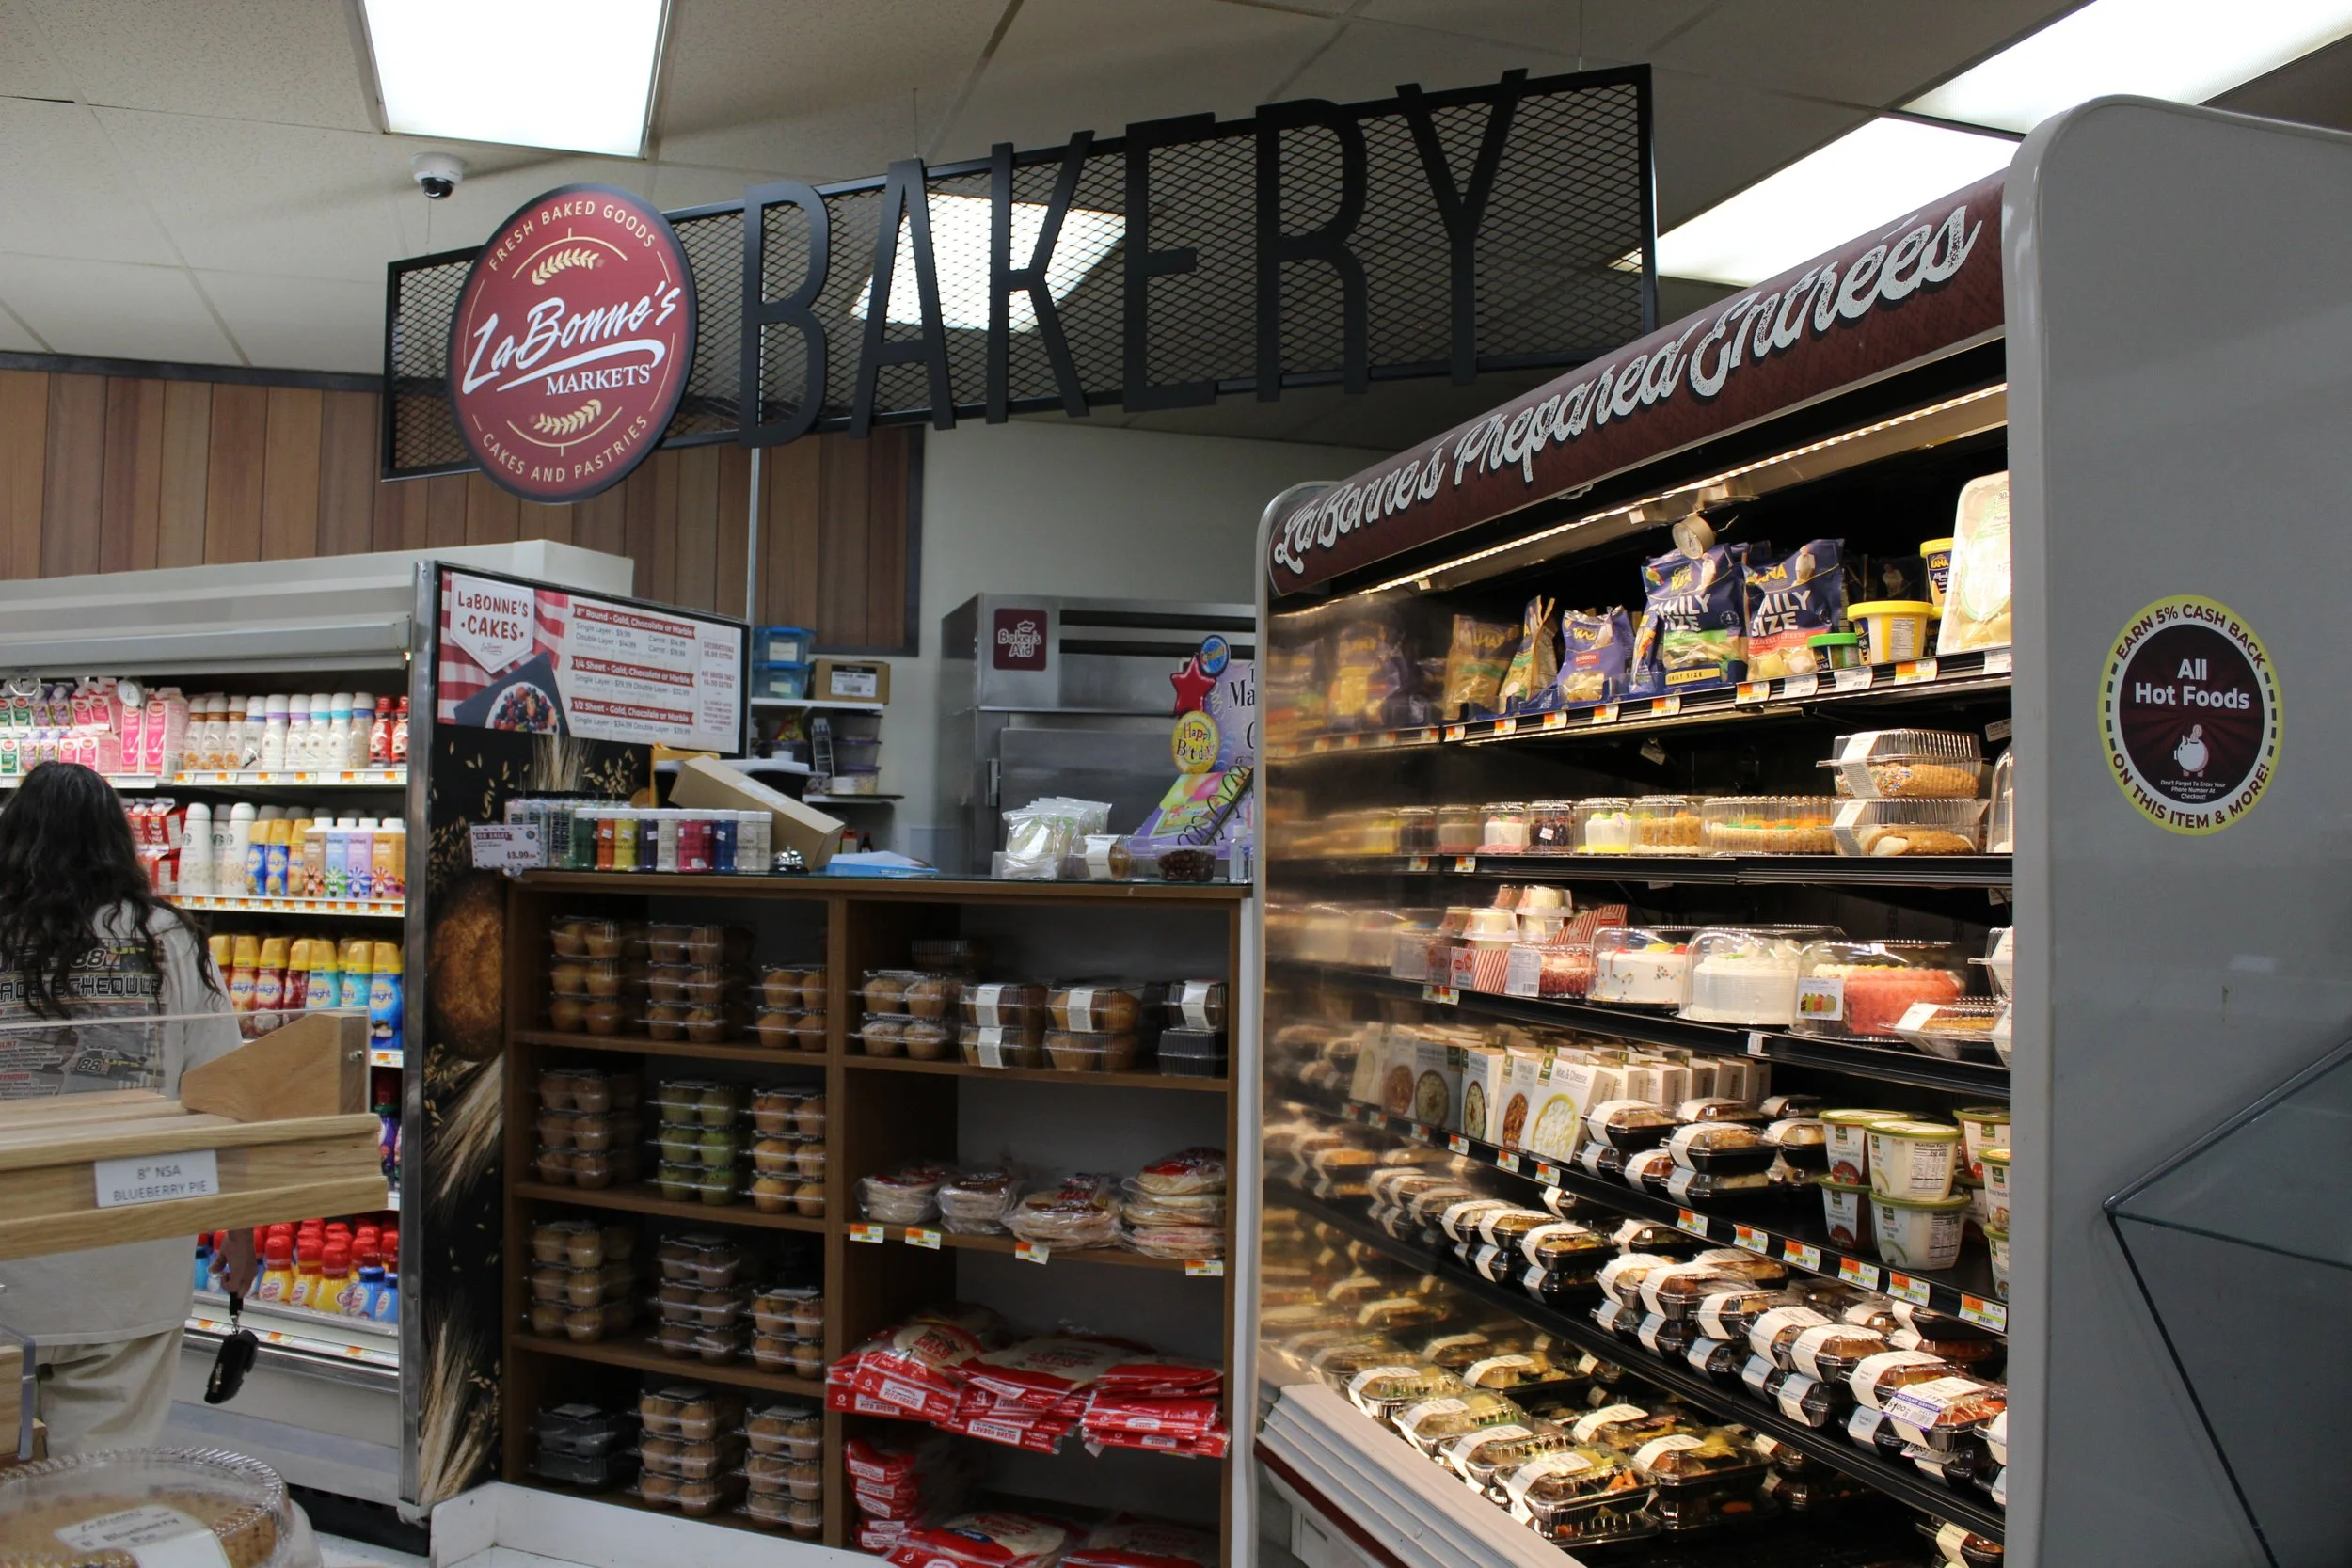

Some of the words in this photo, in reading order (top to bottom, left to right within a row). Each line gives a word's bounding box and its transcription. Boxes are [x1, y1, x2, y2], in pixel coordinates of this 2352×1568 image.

[488, 220, 535, 272] FRESH
[541, 200, 596, 226] BAKED
[603, 204, 656, 248] GOODS
[739, 68, 1529, 450] BAKERY
[461, 280, 681, 395] LaBonne's
[545, 364, 651, 396] MARKETS
[1454, 318, 1708, 485] Prepared
[483, 433, 525, 475] CAKES
[531, 467, 565, 483] AND
[574, 415, 648, 479] PASTRIES
[458, 591, 529, 617] LaBONNE'S
[468, 615, 518, 641] CAKES
[998, 628, 1041, 645] Baker's
[1751, 612, 1799, 637] SIZE
[2115, 614, 2154, 660] EARN
[2155, 606, 2179, 626] 5%
[2182, 604, 2227, 628] CASH
[2227, 621, 2266, 670] BACK
[1009, 642, 1034, 657] Aid
[2177, 658, 2208, 681] All
[1230, 679, 1255, 709] Ma
[2135, 682, 2176, 705] Hot
[2183, 686, 2250, 710] Foods
[2112, 753, 2134, 786] ON
[2132, 783, 2167, 820] THIS
[2169, 810, 2210, 829] ITEM
[2215, 810, 2227, 825] &
[2228, 762, 2270, 818] MORE!
[77, 1057, 103, 1072] 88
[137, 1166, 151, 1180] 8"
[154, 1164, 182, 1178] NSA
[113, 1182, 186, 1201] BLUEBERRY
[188, 1180, 208, 1194] PIE
